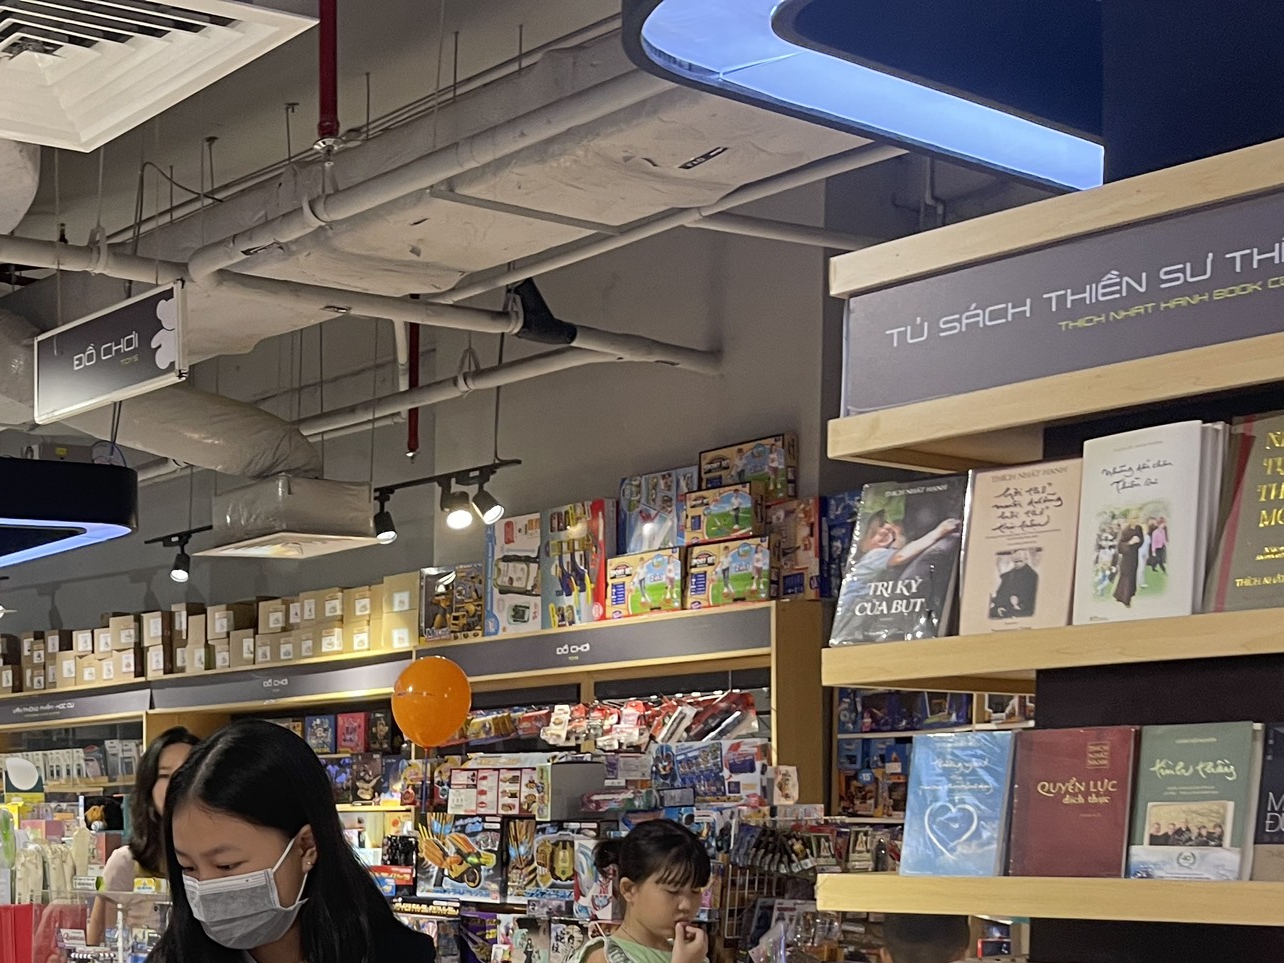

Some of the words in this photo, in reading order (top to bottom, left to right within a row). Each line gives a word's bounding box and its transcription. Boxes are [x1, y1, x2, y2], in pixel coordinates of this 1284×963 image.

[885, 316, 928, 348] TỦ
[938, 298, 1031, 338] SÁCH
[1042, 270, 1148, 313] THIỀN
[1159, 252, 1214, 290] SƯ
[1058, 313, 1106, 333] THICH
[1213, 281, 1263, 301] BOOK
[72, 342, 97, 371] ĐỒ
[100, 330, 139, 360] CHƠI
[854, 598, 888, 617] CỦA
[890, 598, 926, 617] BỤT
[1037, 777, 1086, 797] QUYỀN
[1089, 778, 1118, 796] LỰC
